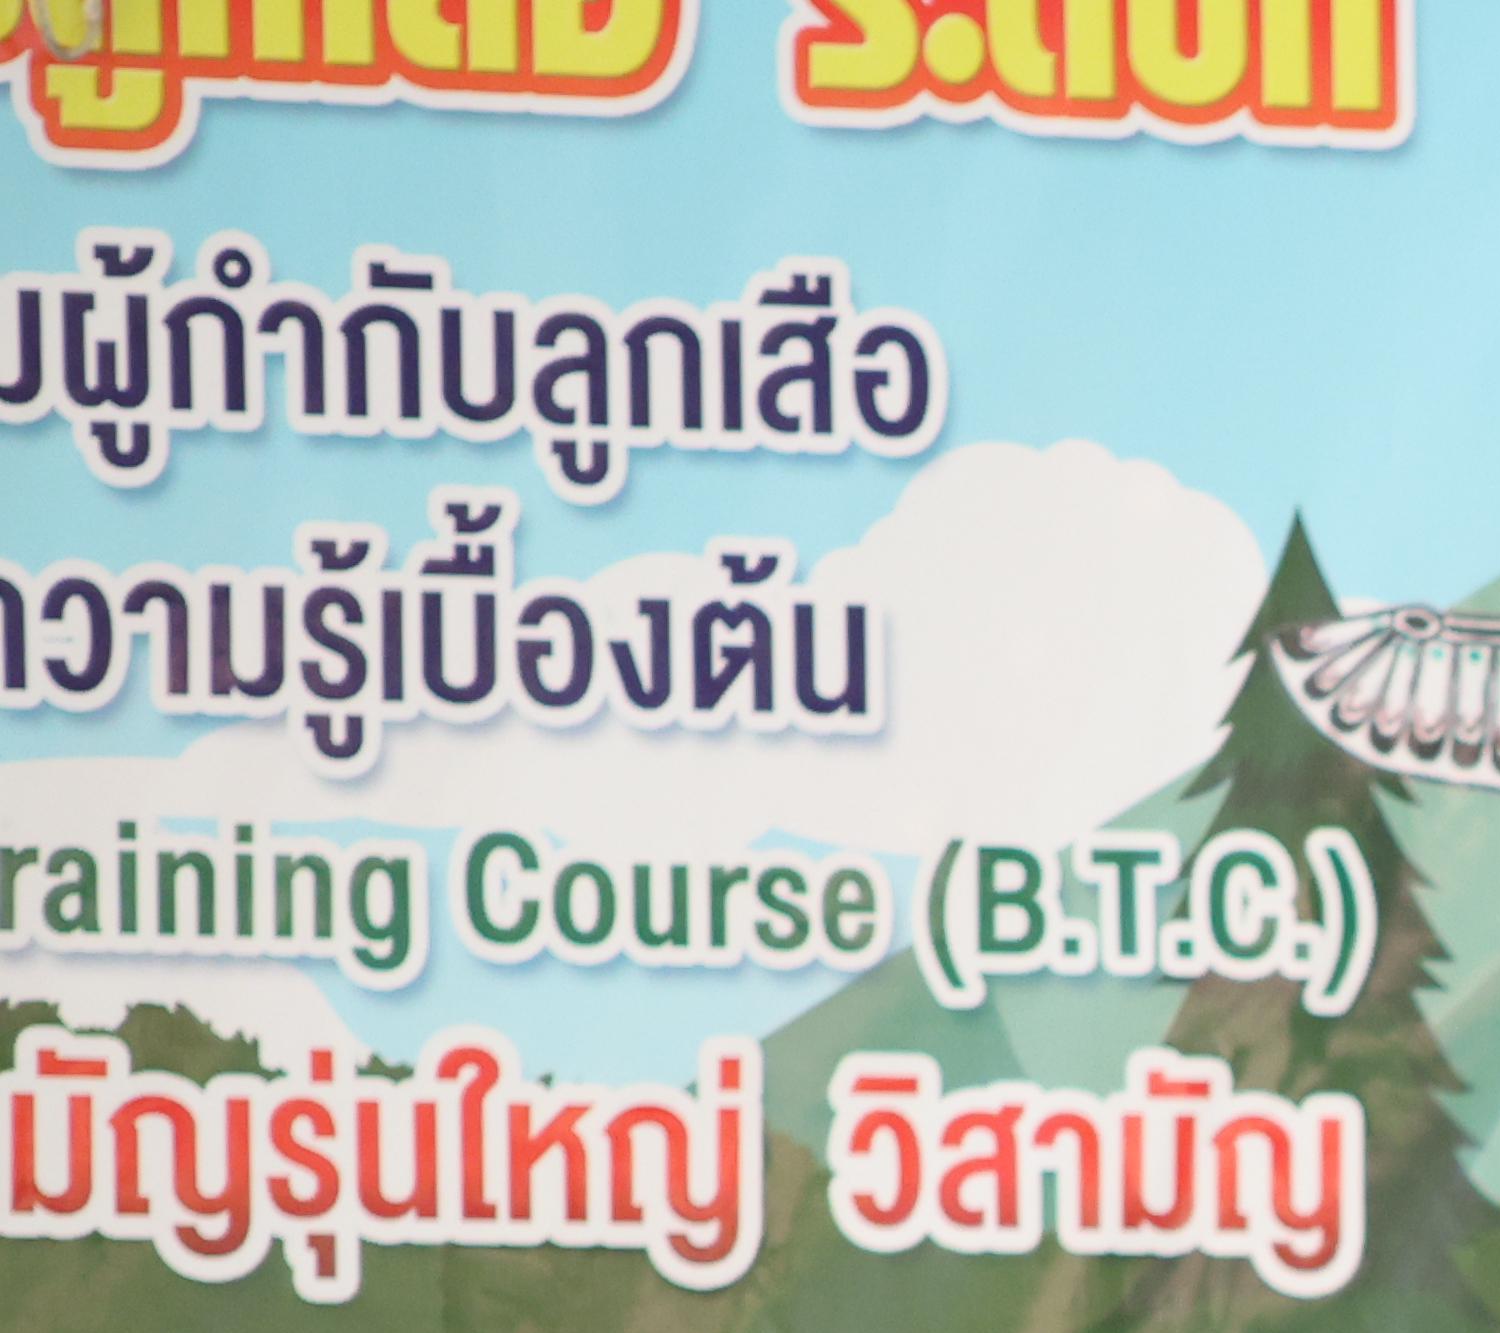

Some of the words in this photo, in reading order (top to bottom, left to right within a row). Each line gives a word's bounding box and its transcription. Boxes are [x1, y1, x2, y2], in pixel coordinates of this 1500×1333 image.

[0, 821, 410, 970] raining
[467, 831, 875, 951] Course
[929, 839, 1358, 996] (B.T.C.)
[11, 1046, 742, 1278] มัญรุ่นใหญ่
[849, 1070, 1343, 1269] วิสามัญ
